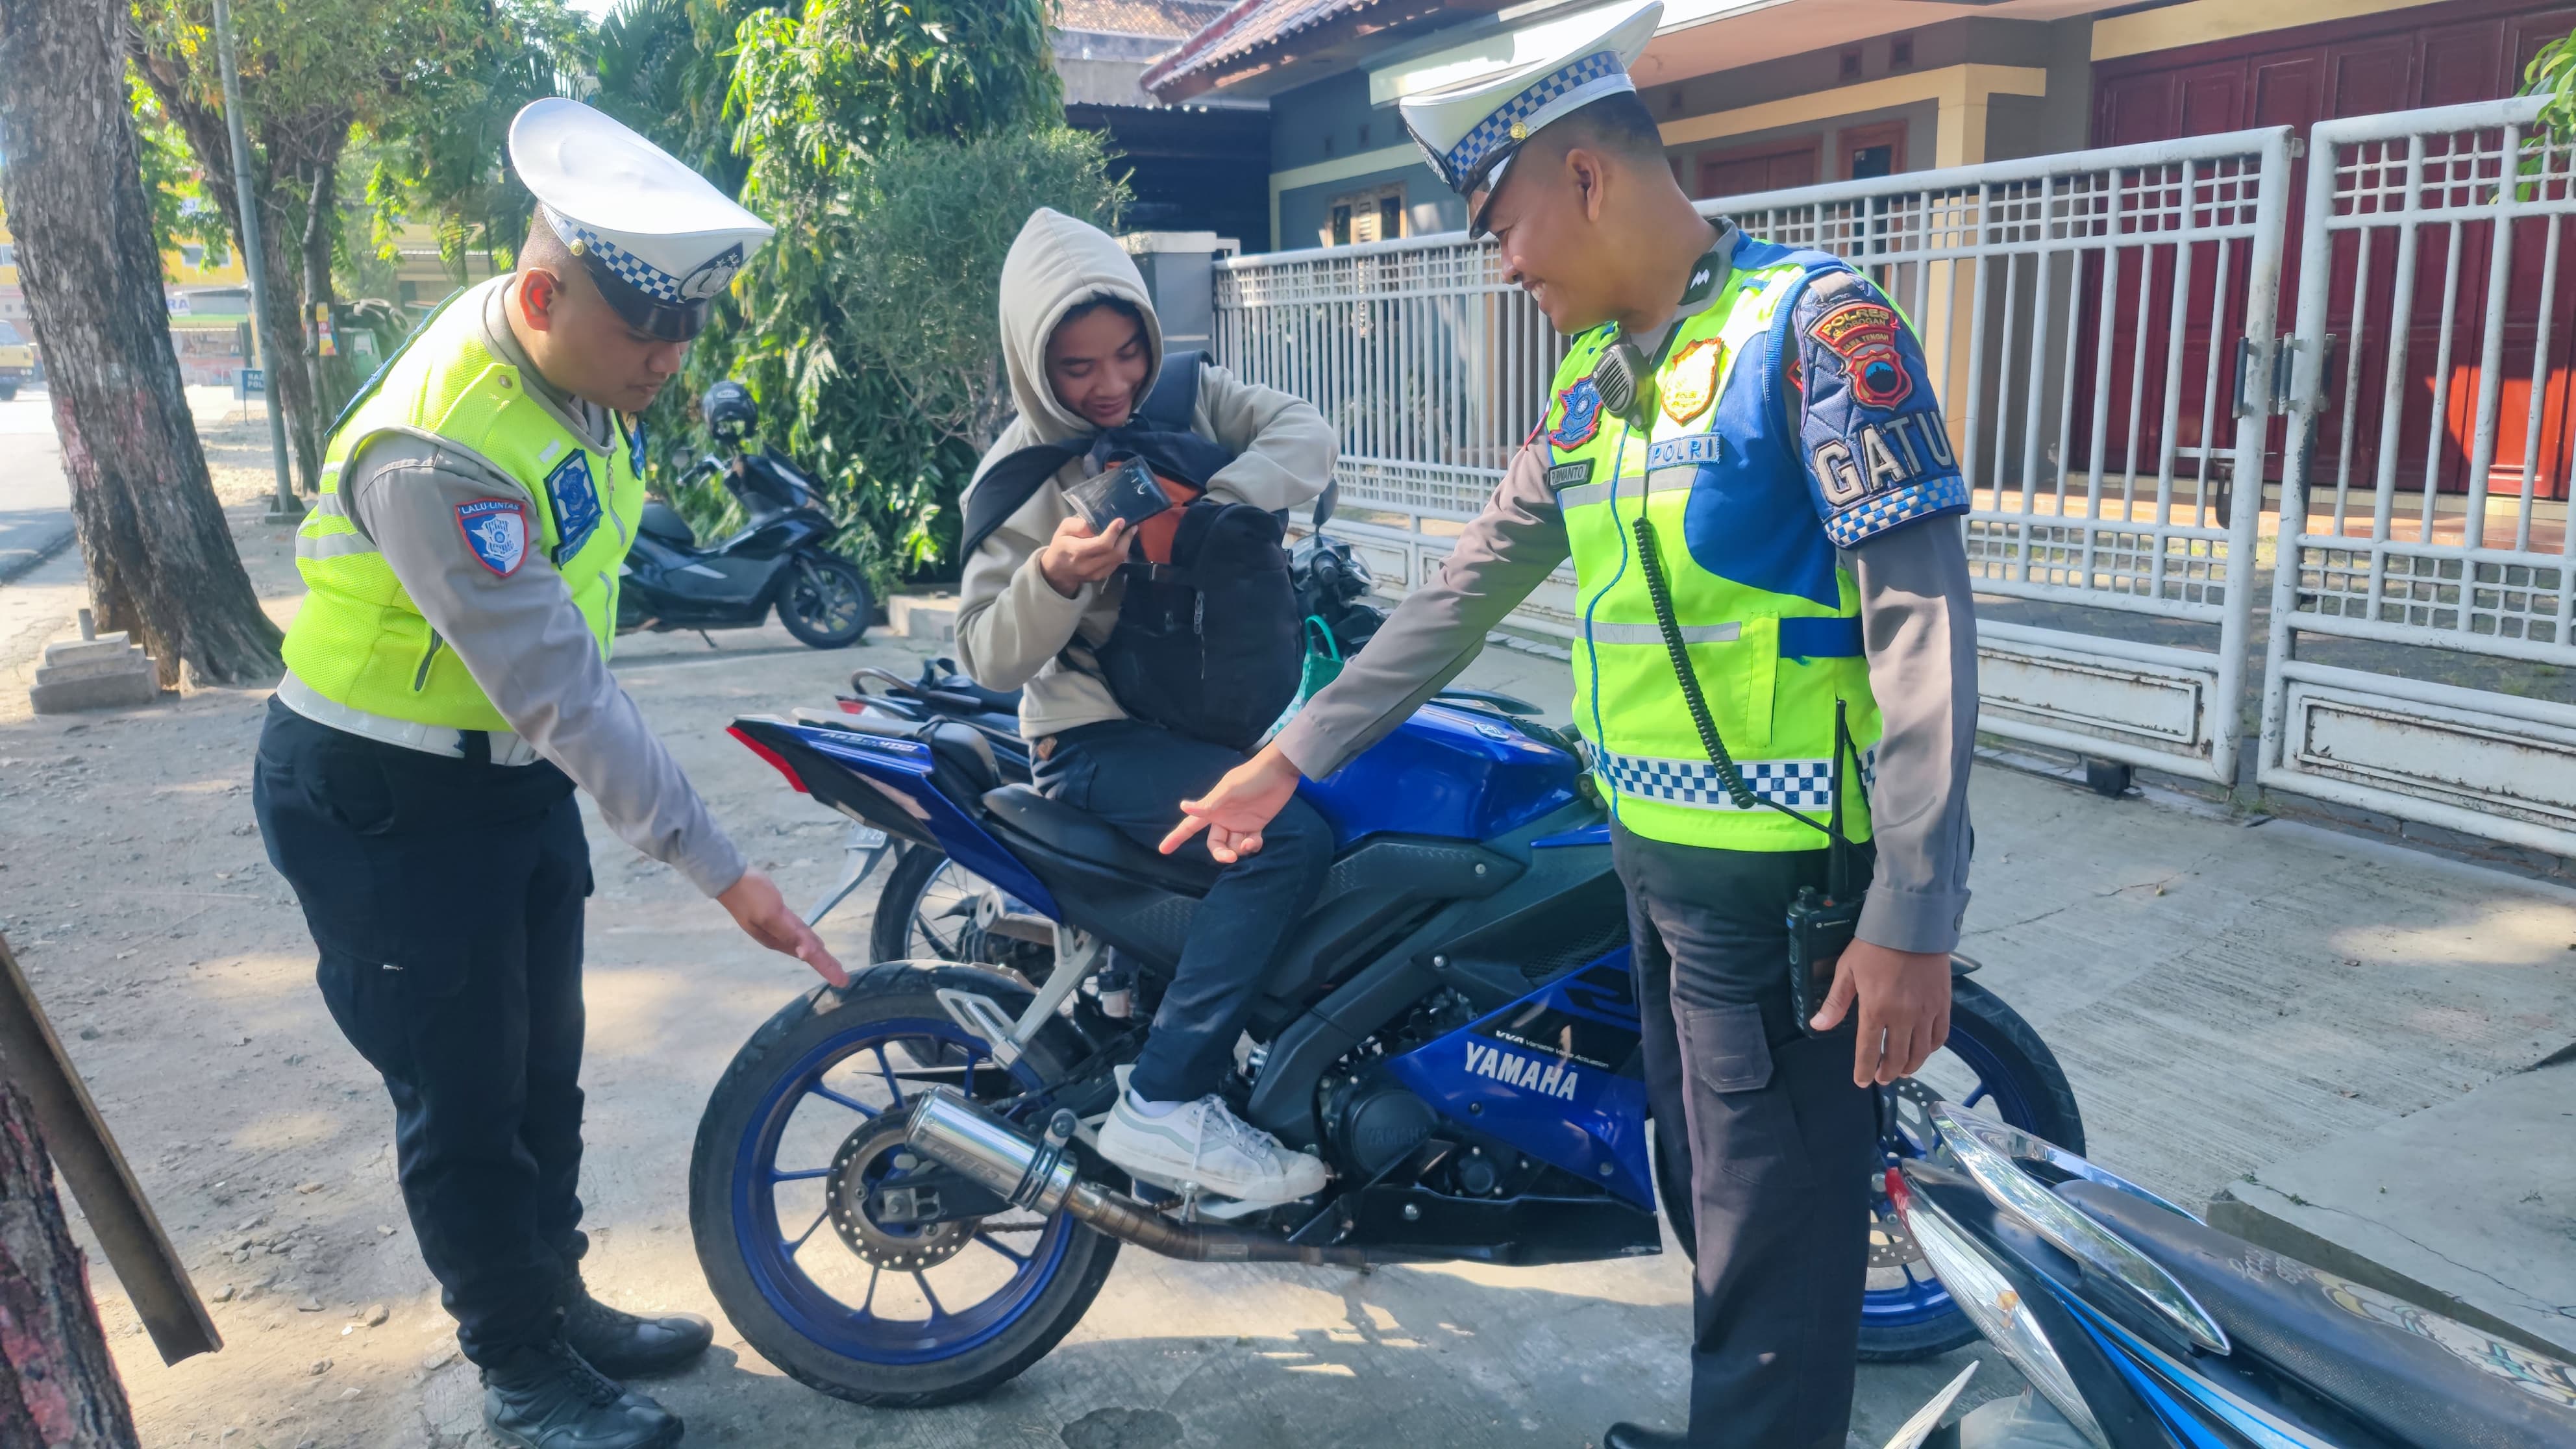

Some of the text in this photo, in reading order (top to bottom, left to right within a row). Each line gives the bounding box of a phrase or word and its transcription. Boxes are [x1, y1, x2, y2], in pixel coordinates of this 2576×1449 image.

[1822, 308, 1890, 336] POLRES
[1862, 332, 1889, 342] TENGAH
[1651, 438, 1713, 464] POLRI
[462, 502, 519, 514] LALU LINTAS
[1496, 1030, 1524, 1044] VVA
[1574, 1054, 1609, 1068] Actuation
[1465, 1041, 1578, 1101] YAMAHA
